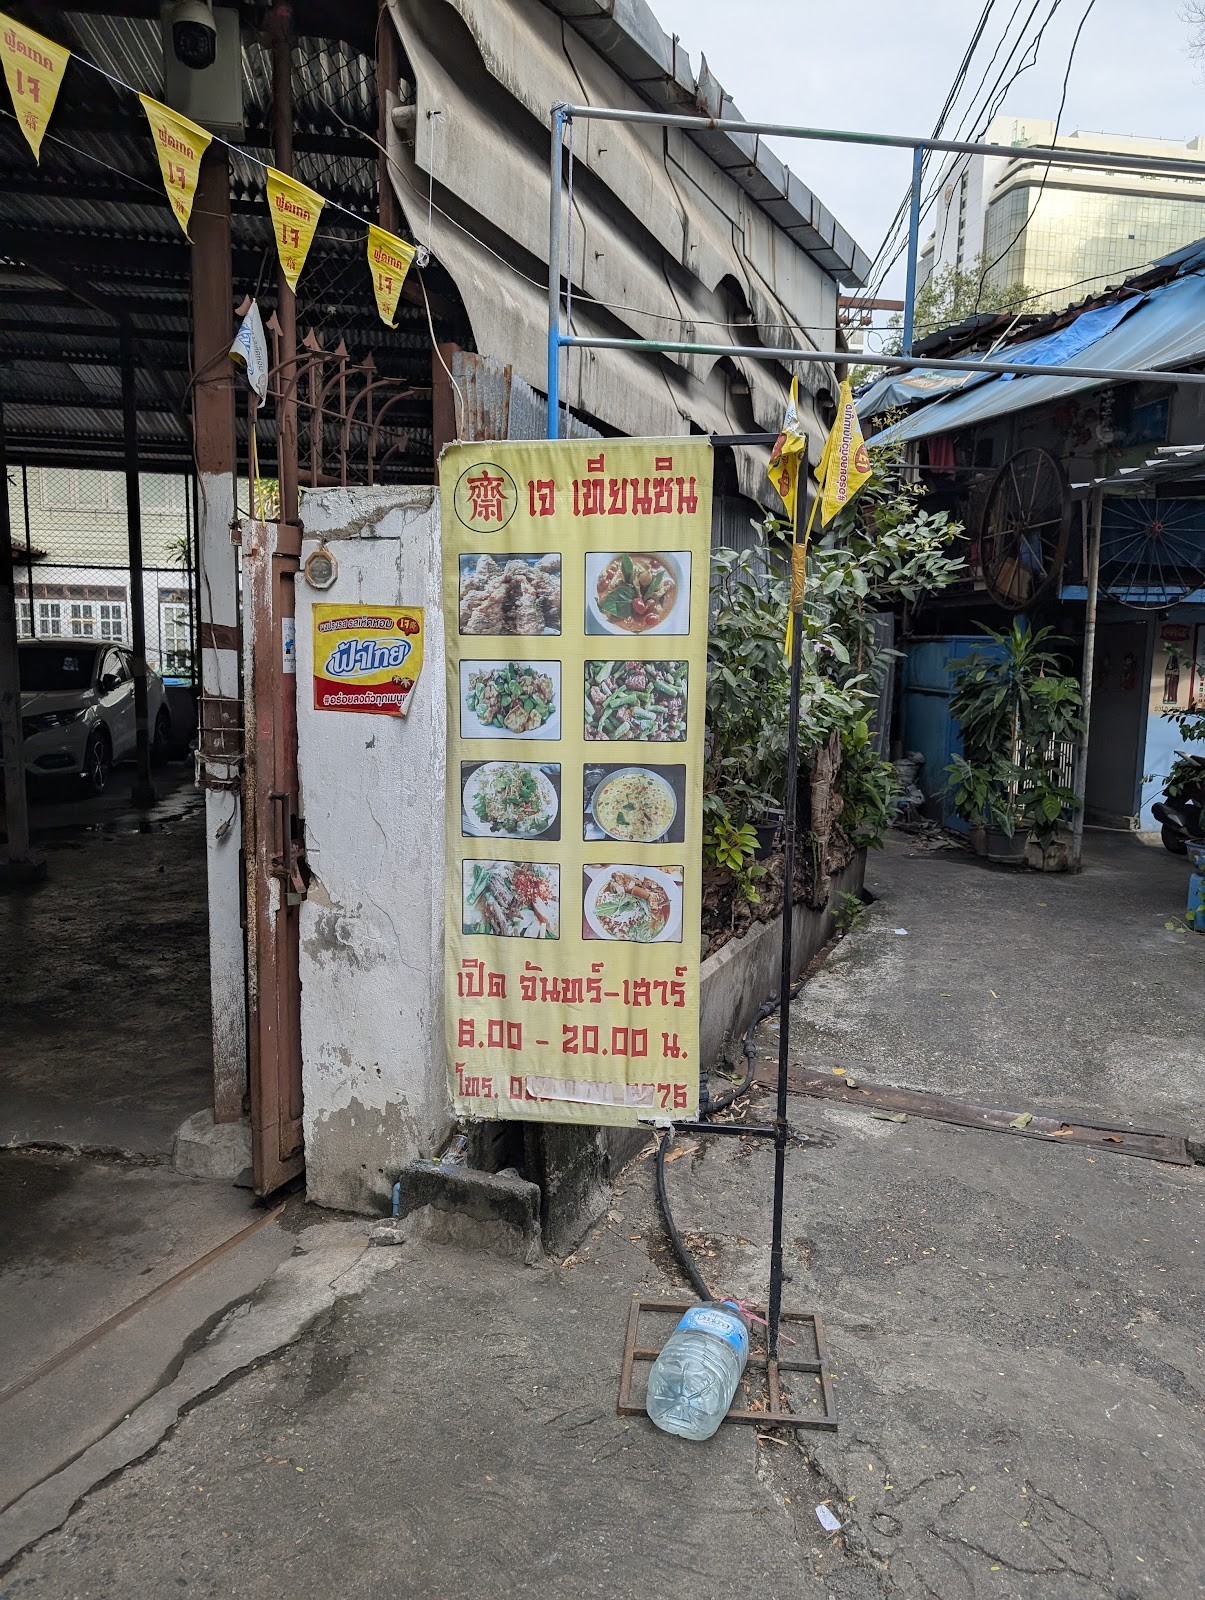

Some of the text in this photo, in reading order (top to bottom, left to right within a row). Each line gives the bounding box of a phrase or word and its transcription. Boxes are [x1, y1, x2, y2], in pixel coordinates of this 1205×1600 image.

[16, 68, 40, 103] เจ
[167, 160, 186, 190] เจ
[281, 223, 300, 248] เจ
[378, 273, 393, 295] เจ
[466, 470, 509, 522] 齋
[528, 479, 556, 517] เจ
[331, 639, 406, 673] ฟ้าไทย
[457, 958, 507, 999] เปิด
[457, 1018, 523, 1051] 6.00
[562, 1024, 649, 1058] 20.00
[661, 1032, 688, 1060] น.
[455, 1062, 499, 1099] โทร.
